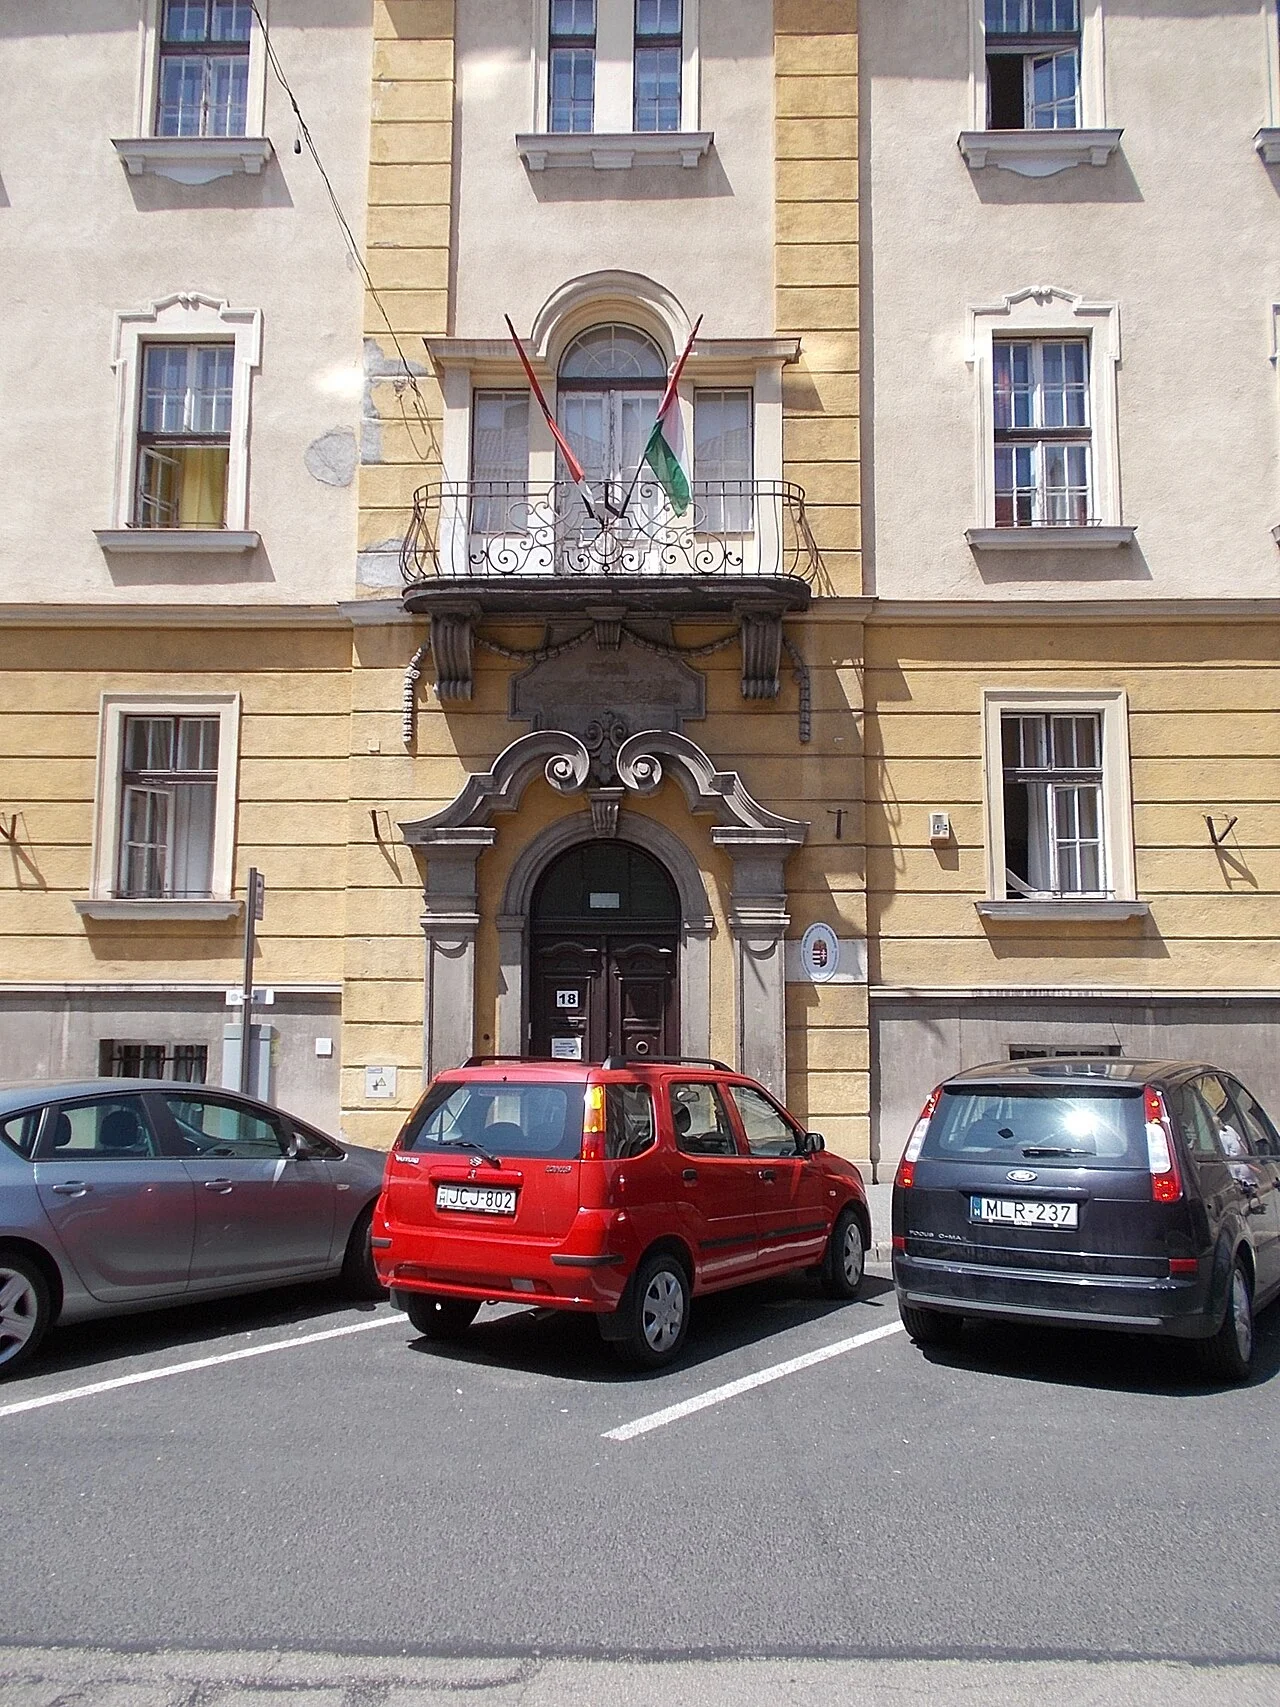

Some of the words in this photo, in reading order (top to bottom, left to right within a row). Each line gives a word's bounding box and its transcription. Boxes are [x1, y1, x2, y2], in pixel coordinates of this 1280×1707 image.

[559, 993, 576, 1004] 18
[449, 1188, 512, 1209] JCJ-802
[986, 1200, 1071, 1222] MLR-237
